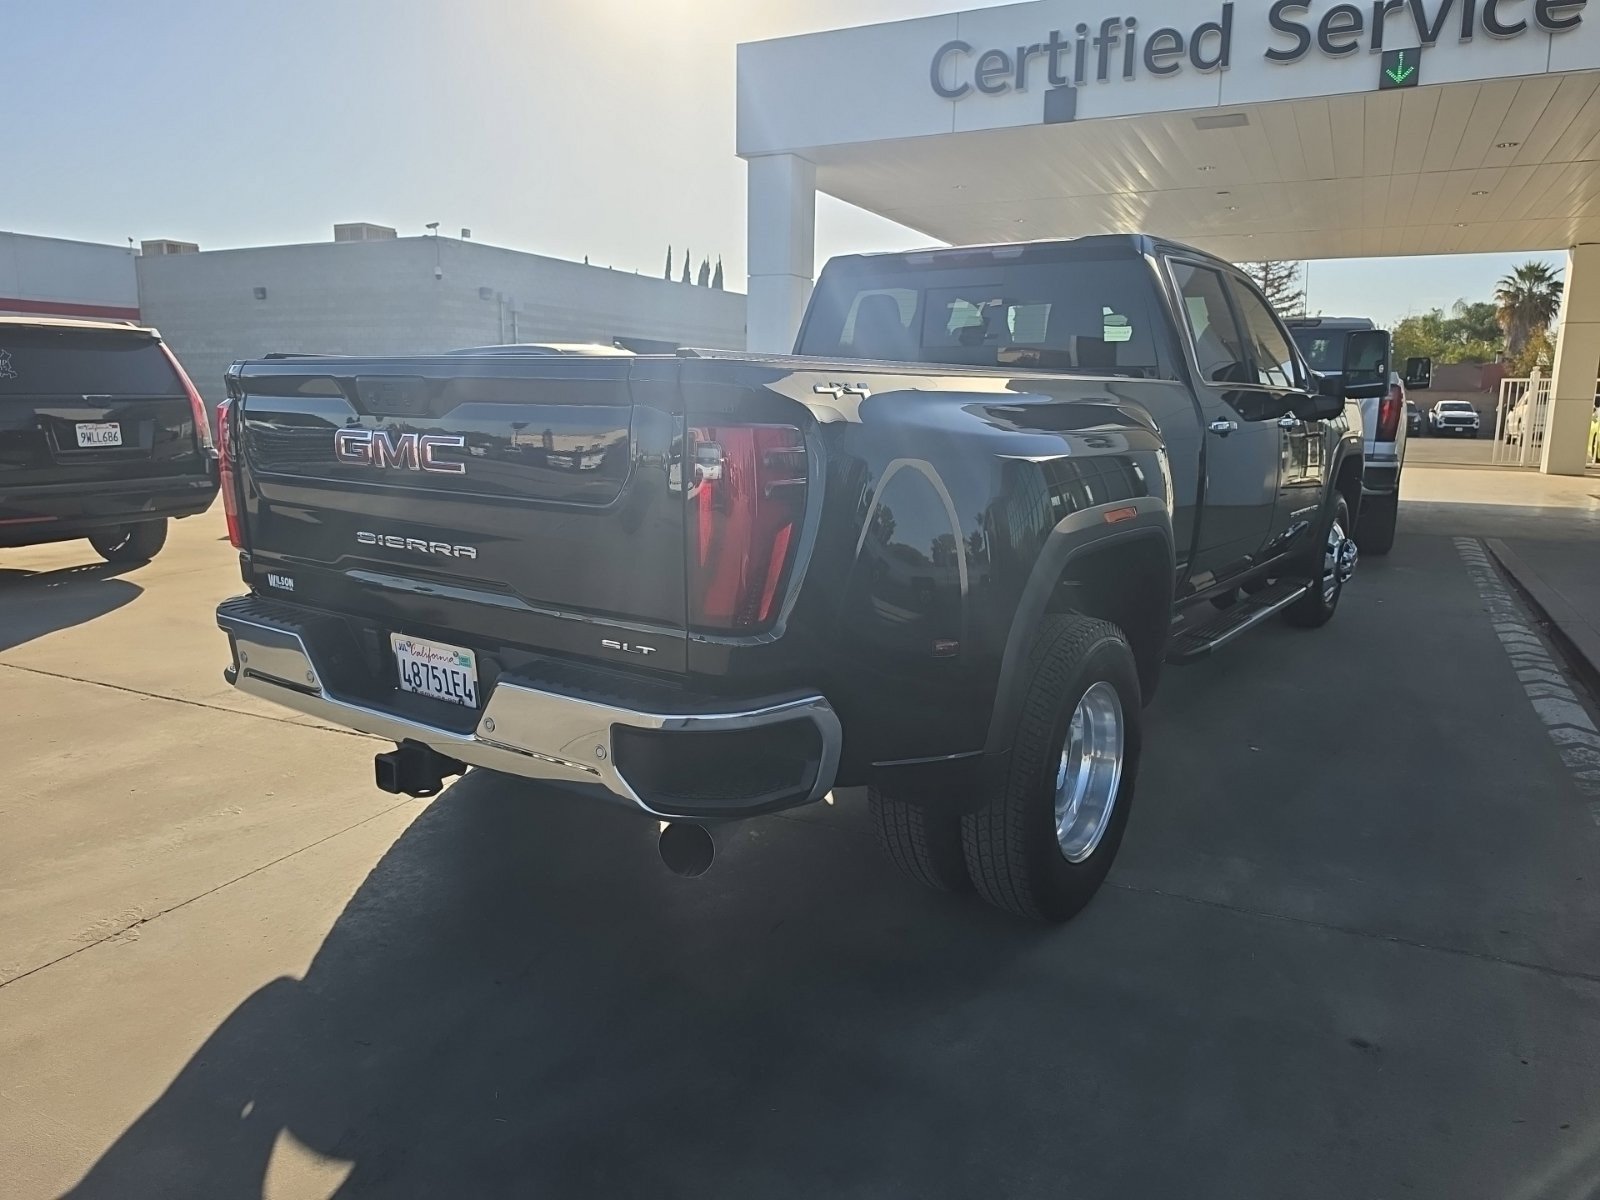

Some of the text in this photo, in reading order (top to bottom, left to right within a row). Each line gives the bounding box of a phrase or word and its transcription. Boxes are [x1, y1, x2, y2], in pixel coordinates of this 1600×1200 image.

[930, 0, 1588, 101] Certified Service
[335, 428, 466, 474] GMC
[356, 531, 477, 559] SIERRA
[267, 573, 294, 588] WILSON
[410, 643, 454, 663] California
[601, 639, 657, 655] SLT
[402, 658, 474, 702] 48751E4
